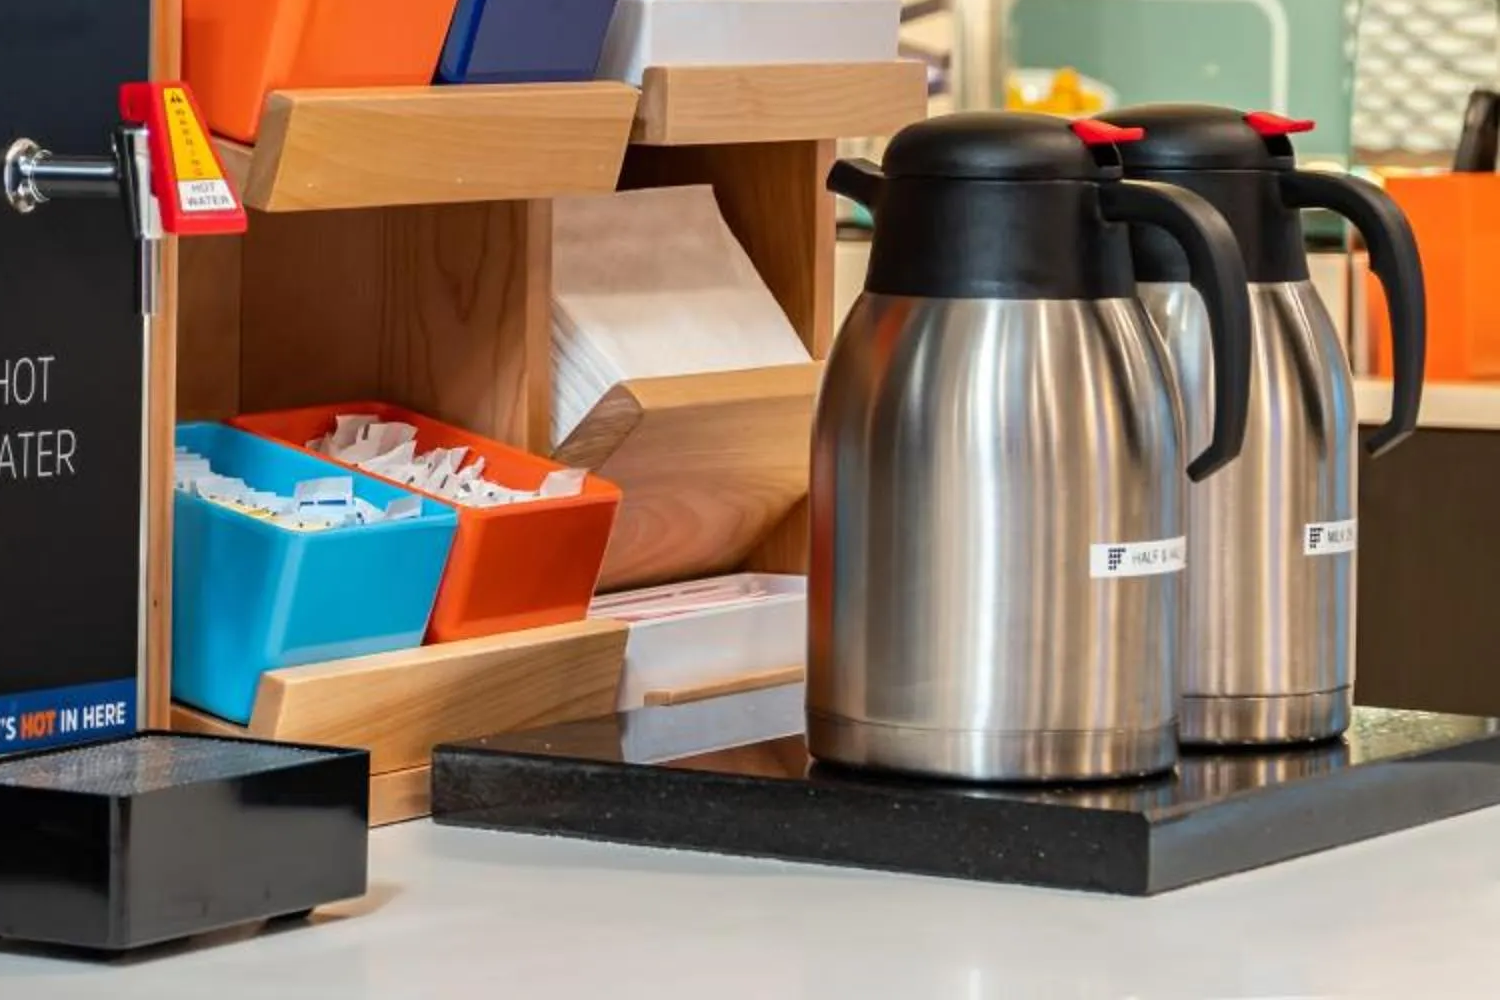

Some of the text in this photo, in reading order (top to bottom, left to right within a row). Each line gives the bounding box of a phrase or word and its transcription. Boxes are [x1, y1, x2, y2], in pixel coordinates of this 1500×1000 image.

[191, 183, 216, 193] HOT
[187, 195, 231, 207] WATER
[19, 709, 57, 741] HOT
[61, 708, 78, 733] IN
[83, 701, 127, 729] HERE
